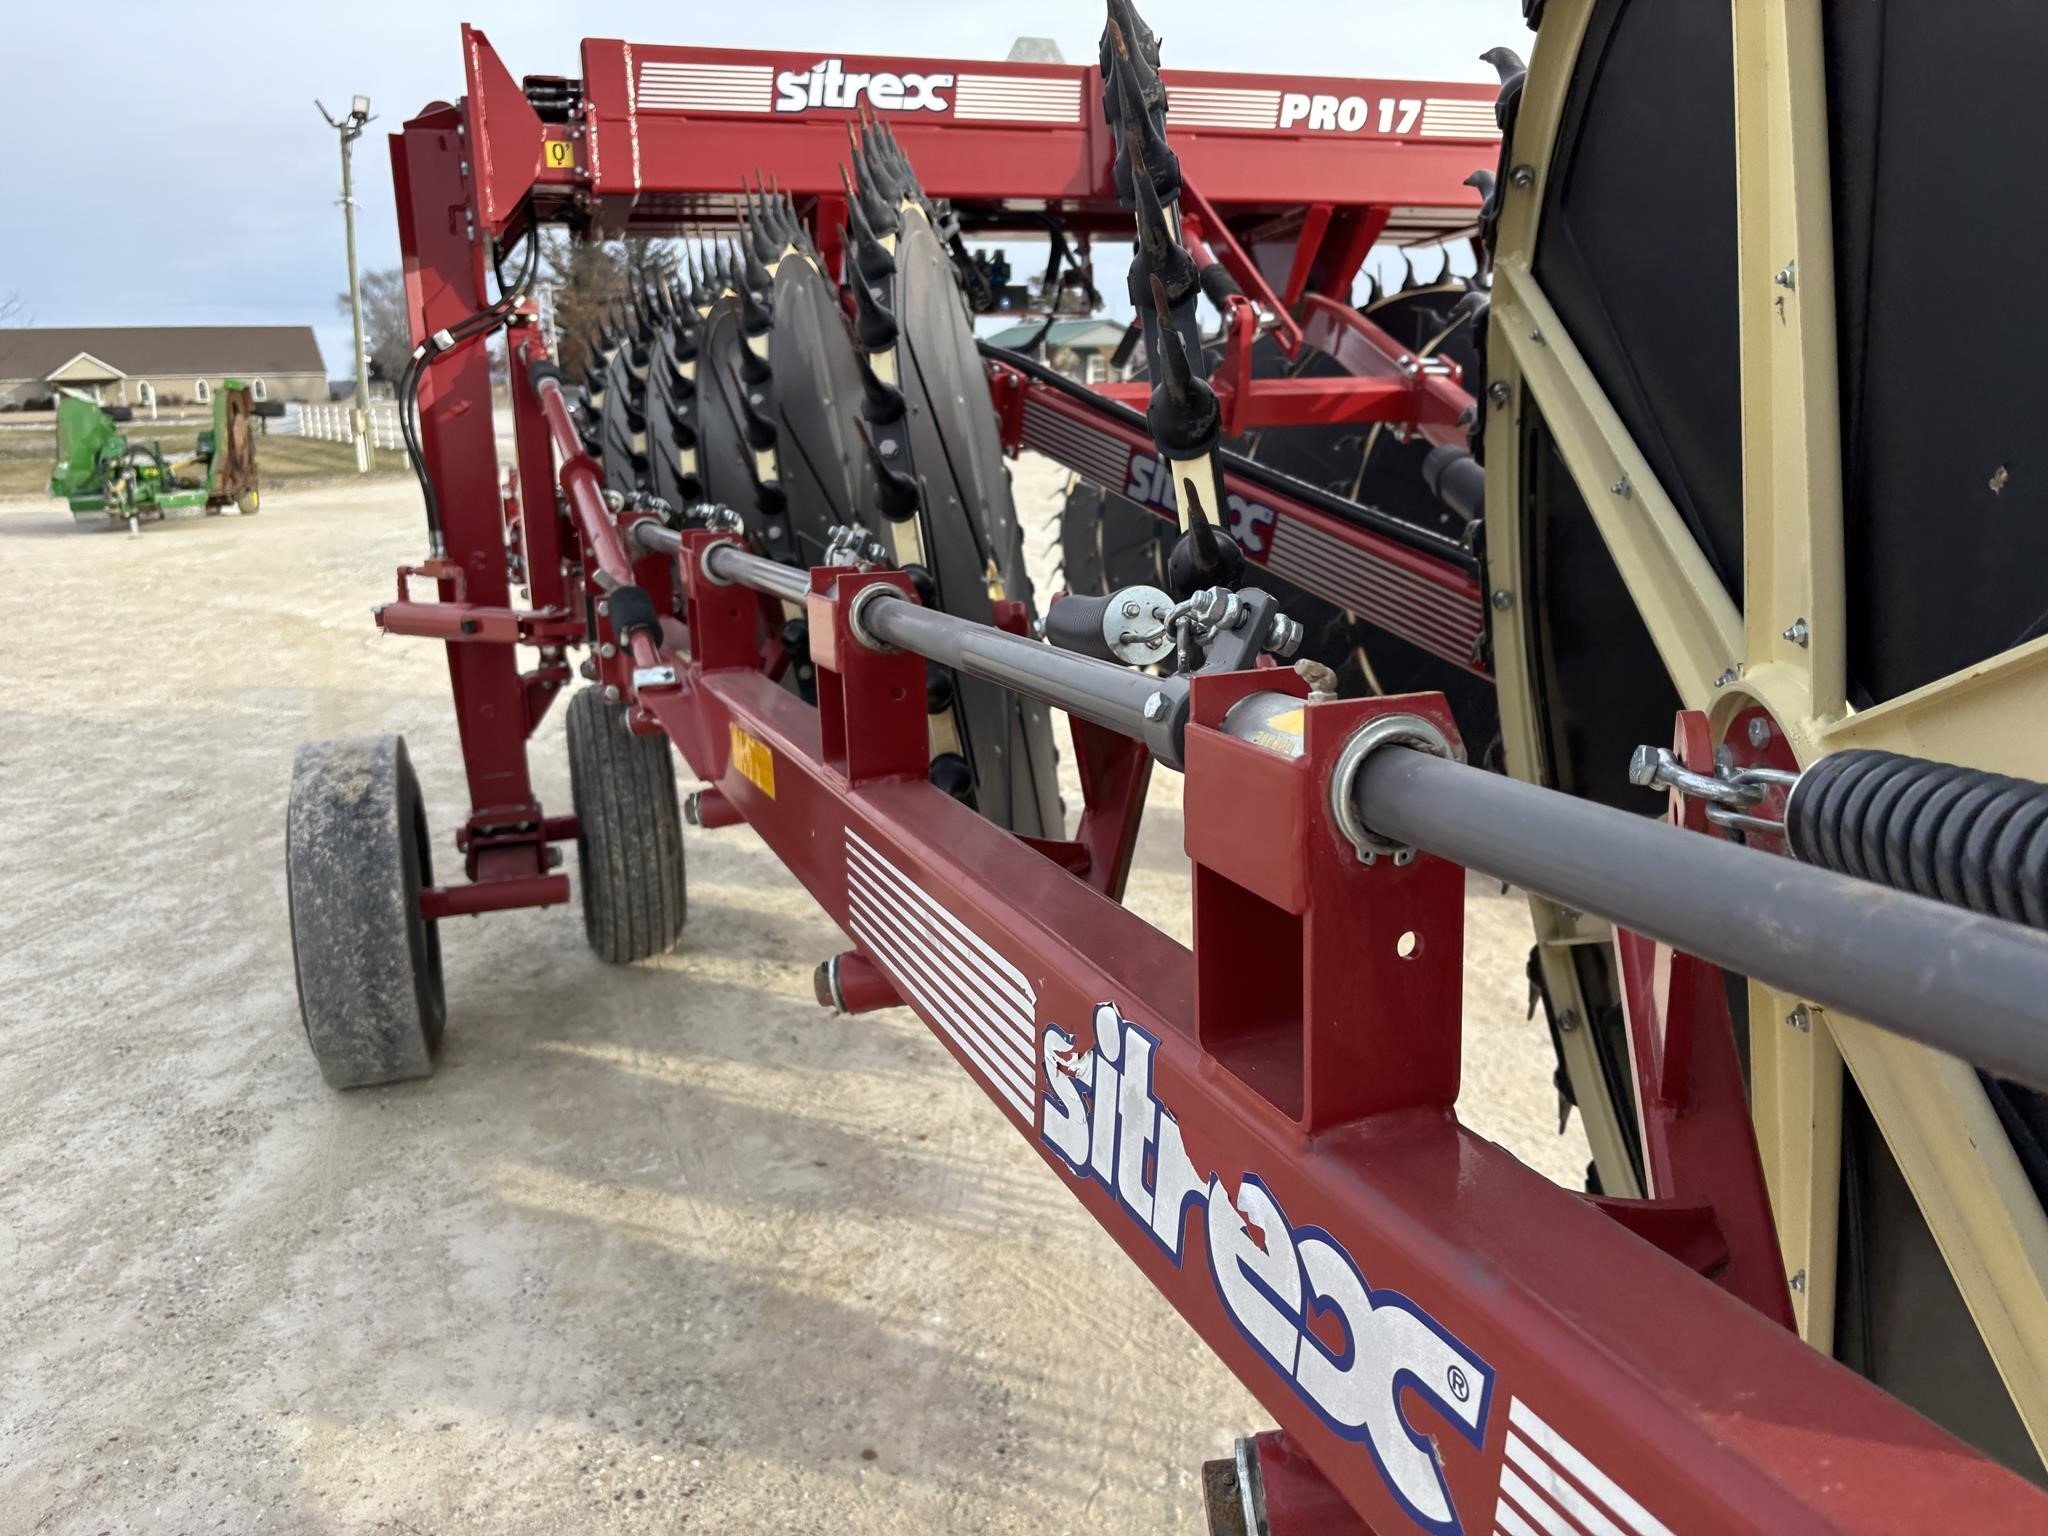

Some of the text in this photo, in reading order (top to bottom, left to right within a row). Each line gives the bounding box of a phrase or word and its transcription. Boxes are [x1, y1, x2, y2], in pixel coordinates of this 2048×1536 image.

[775, 58, 954, 112] sitrex
[1279, 93, 1422, 134] PRO 17
[1041, 1002, 1493, 1528] sitrex
